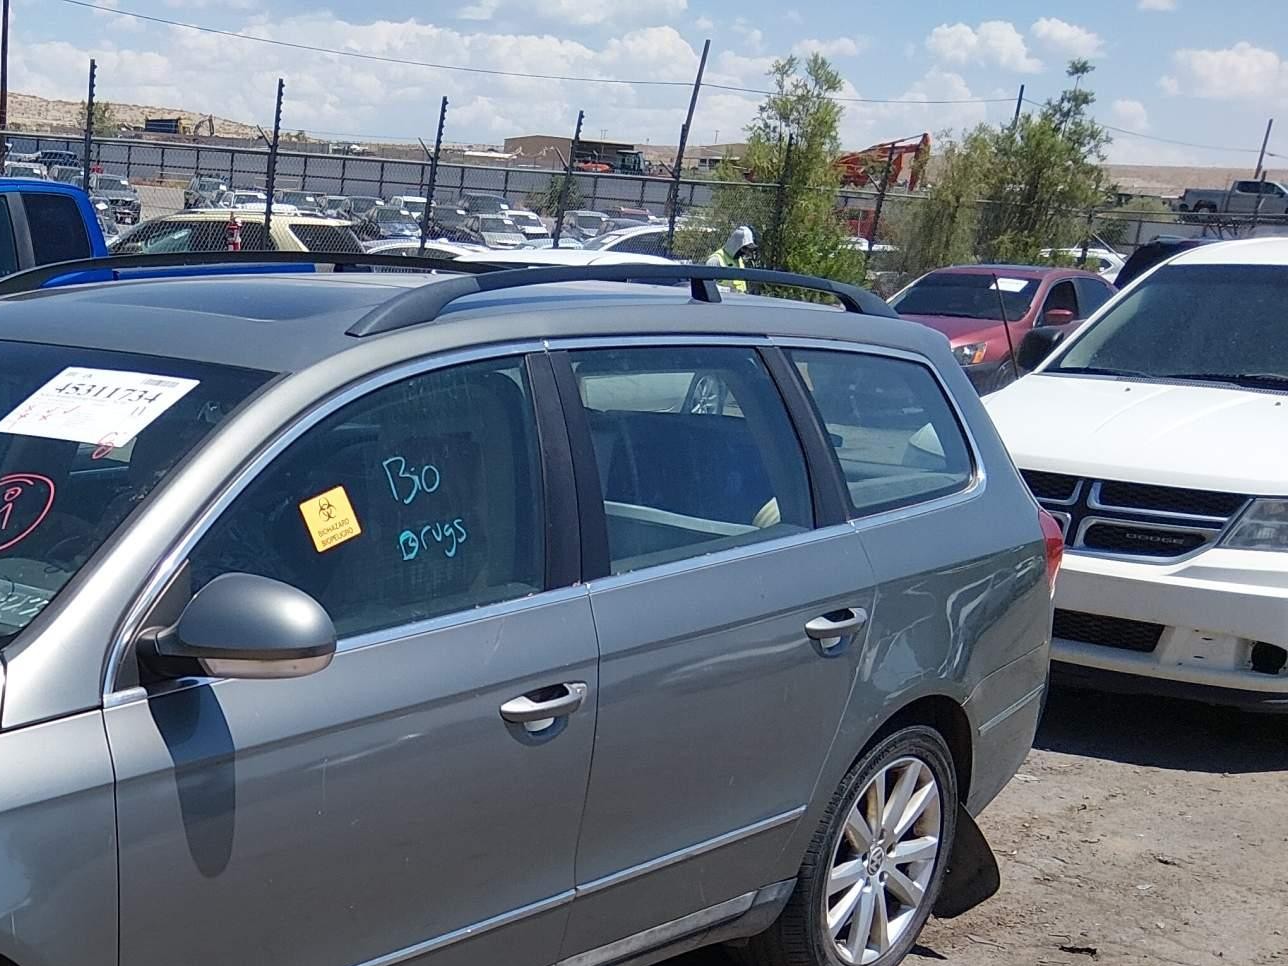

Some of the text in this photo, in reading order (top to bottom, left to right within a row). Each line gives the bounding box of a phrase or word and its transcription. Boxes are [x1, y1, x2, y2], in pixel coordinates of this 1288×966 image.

[55, 382, 163, 404] 45311734
[382, 456, 440, 504] Bio
[317, 518, 350, 538] BIOHAZARD
[1124, 532, 1185, 545] DODGE
